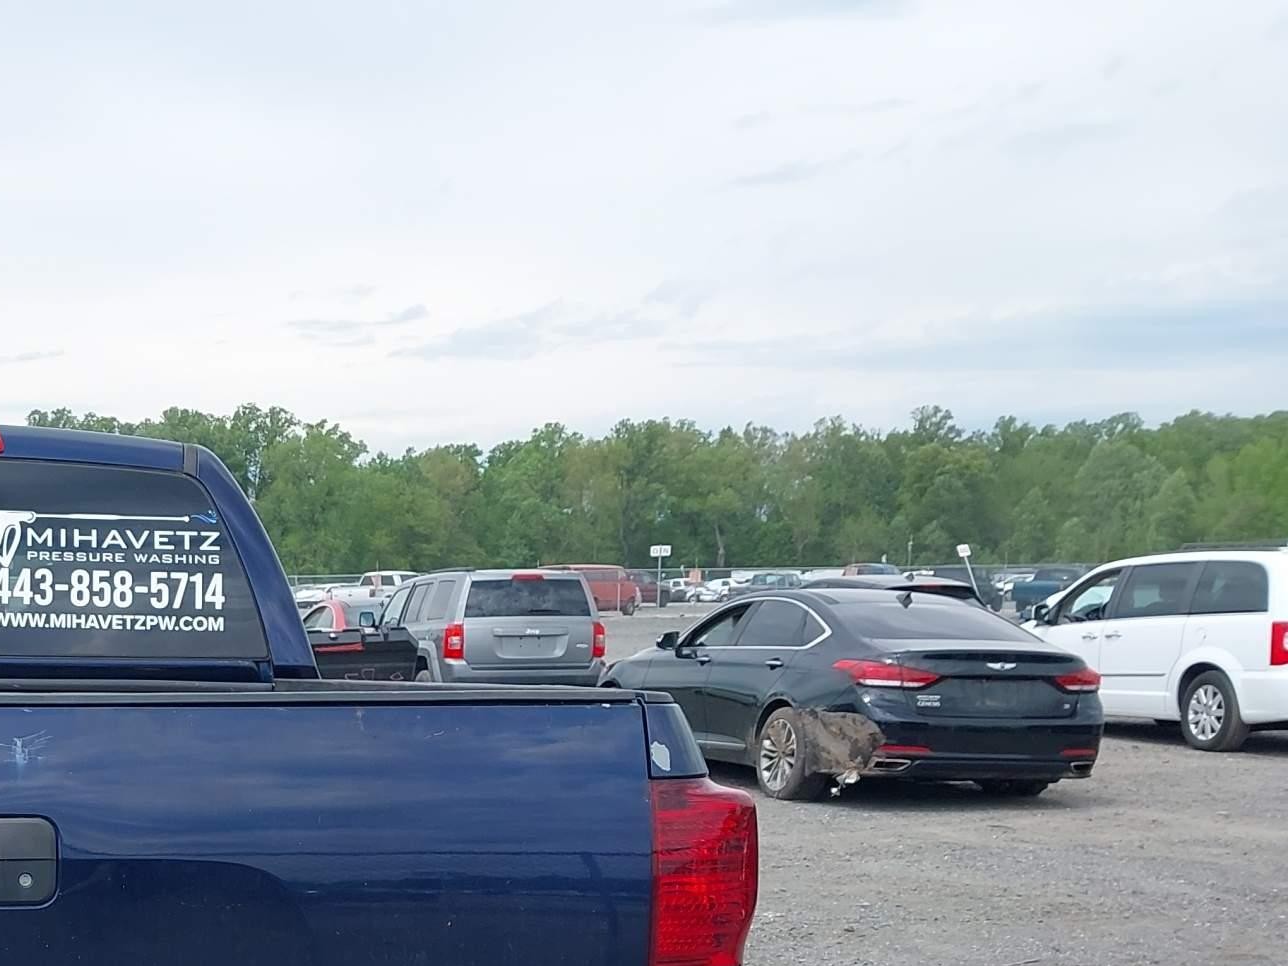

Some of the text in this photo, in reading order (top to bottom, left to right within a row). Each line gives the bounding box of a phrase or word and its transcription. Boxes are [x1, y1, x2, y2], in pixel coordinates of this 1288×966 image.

[26, 527, 222, 551] MIHAVETZ
[26, 550, 221, 566] PRESSURE WASHING
